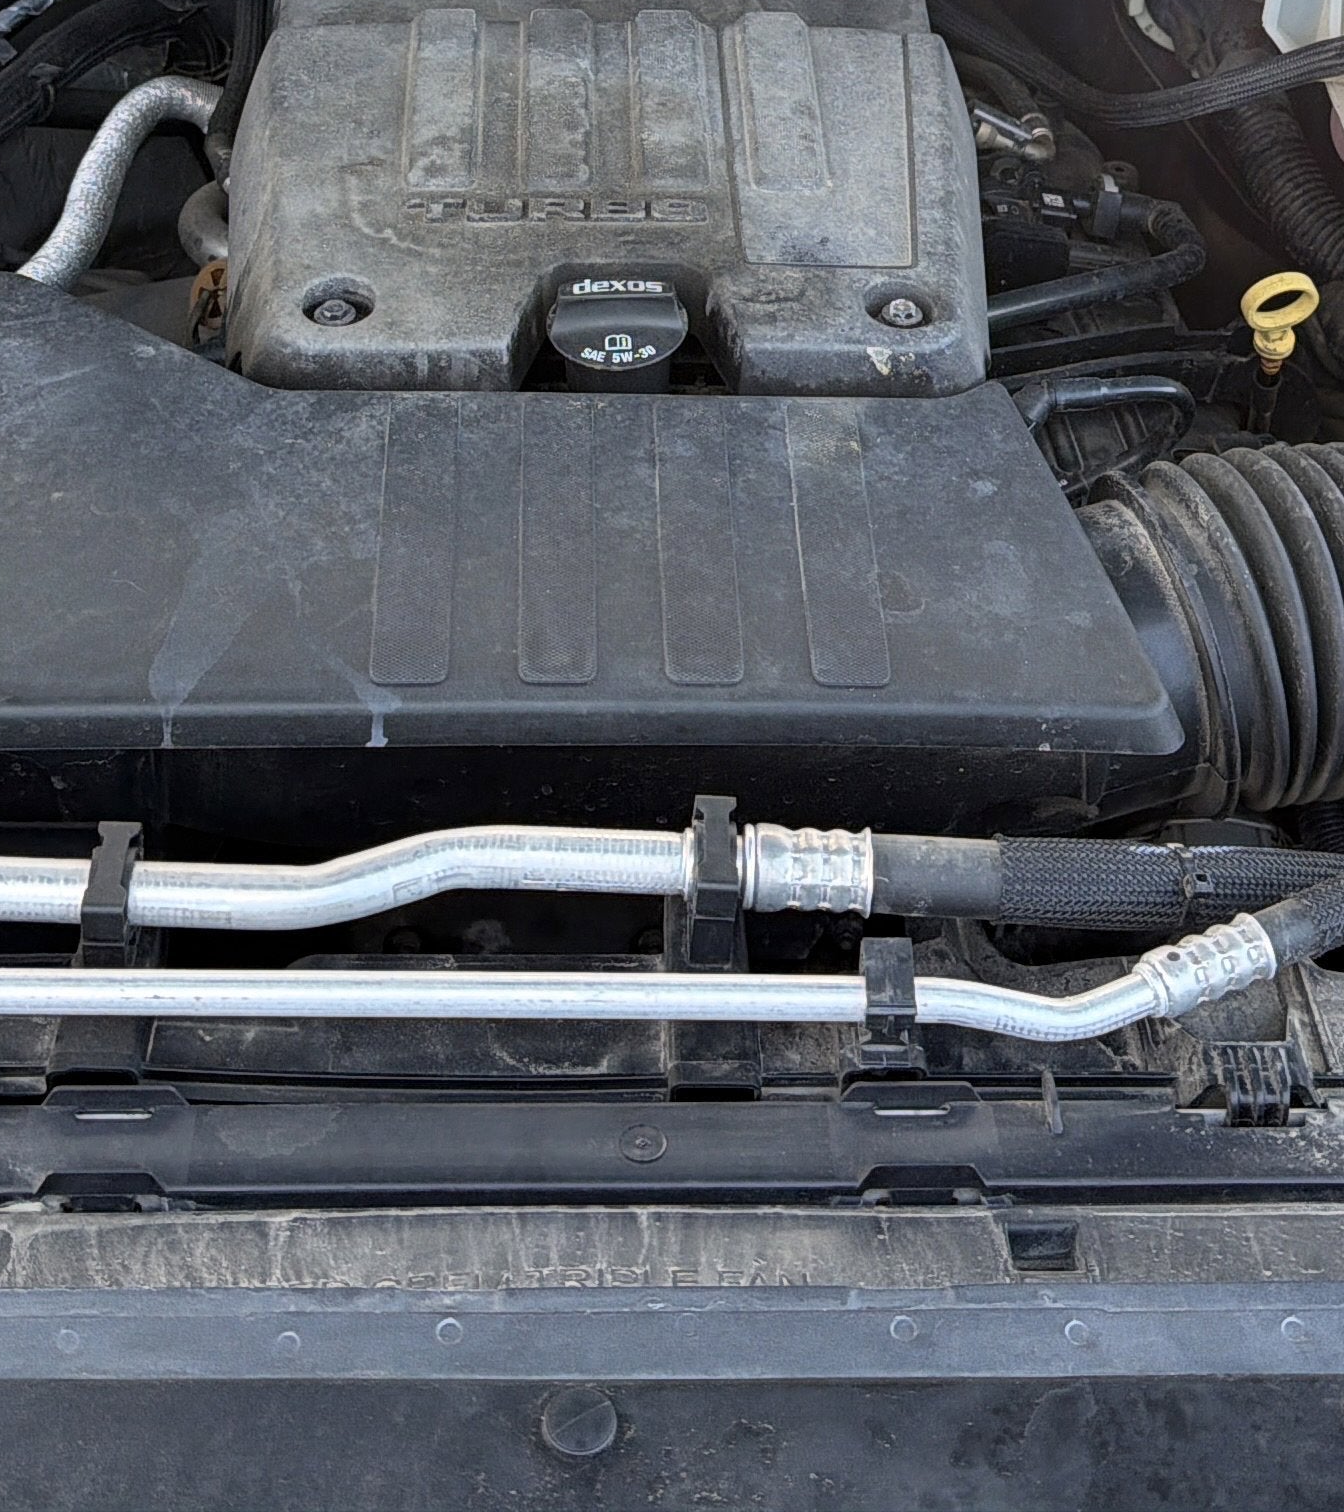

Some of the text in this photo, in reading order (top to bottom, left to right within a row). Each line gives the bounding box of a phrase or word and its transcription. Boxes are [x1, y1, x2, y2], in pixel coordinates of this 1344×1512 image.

[404, 196, 707, 223] TURBO
[572, 278, 663, 295] dexos
[580, 344, 657, 364] SAE 5W-30
